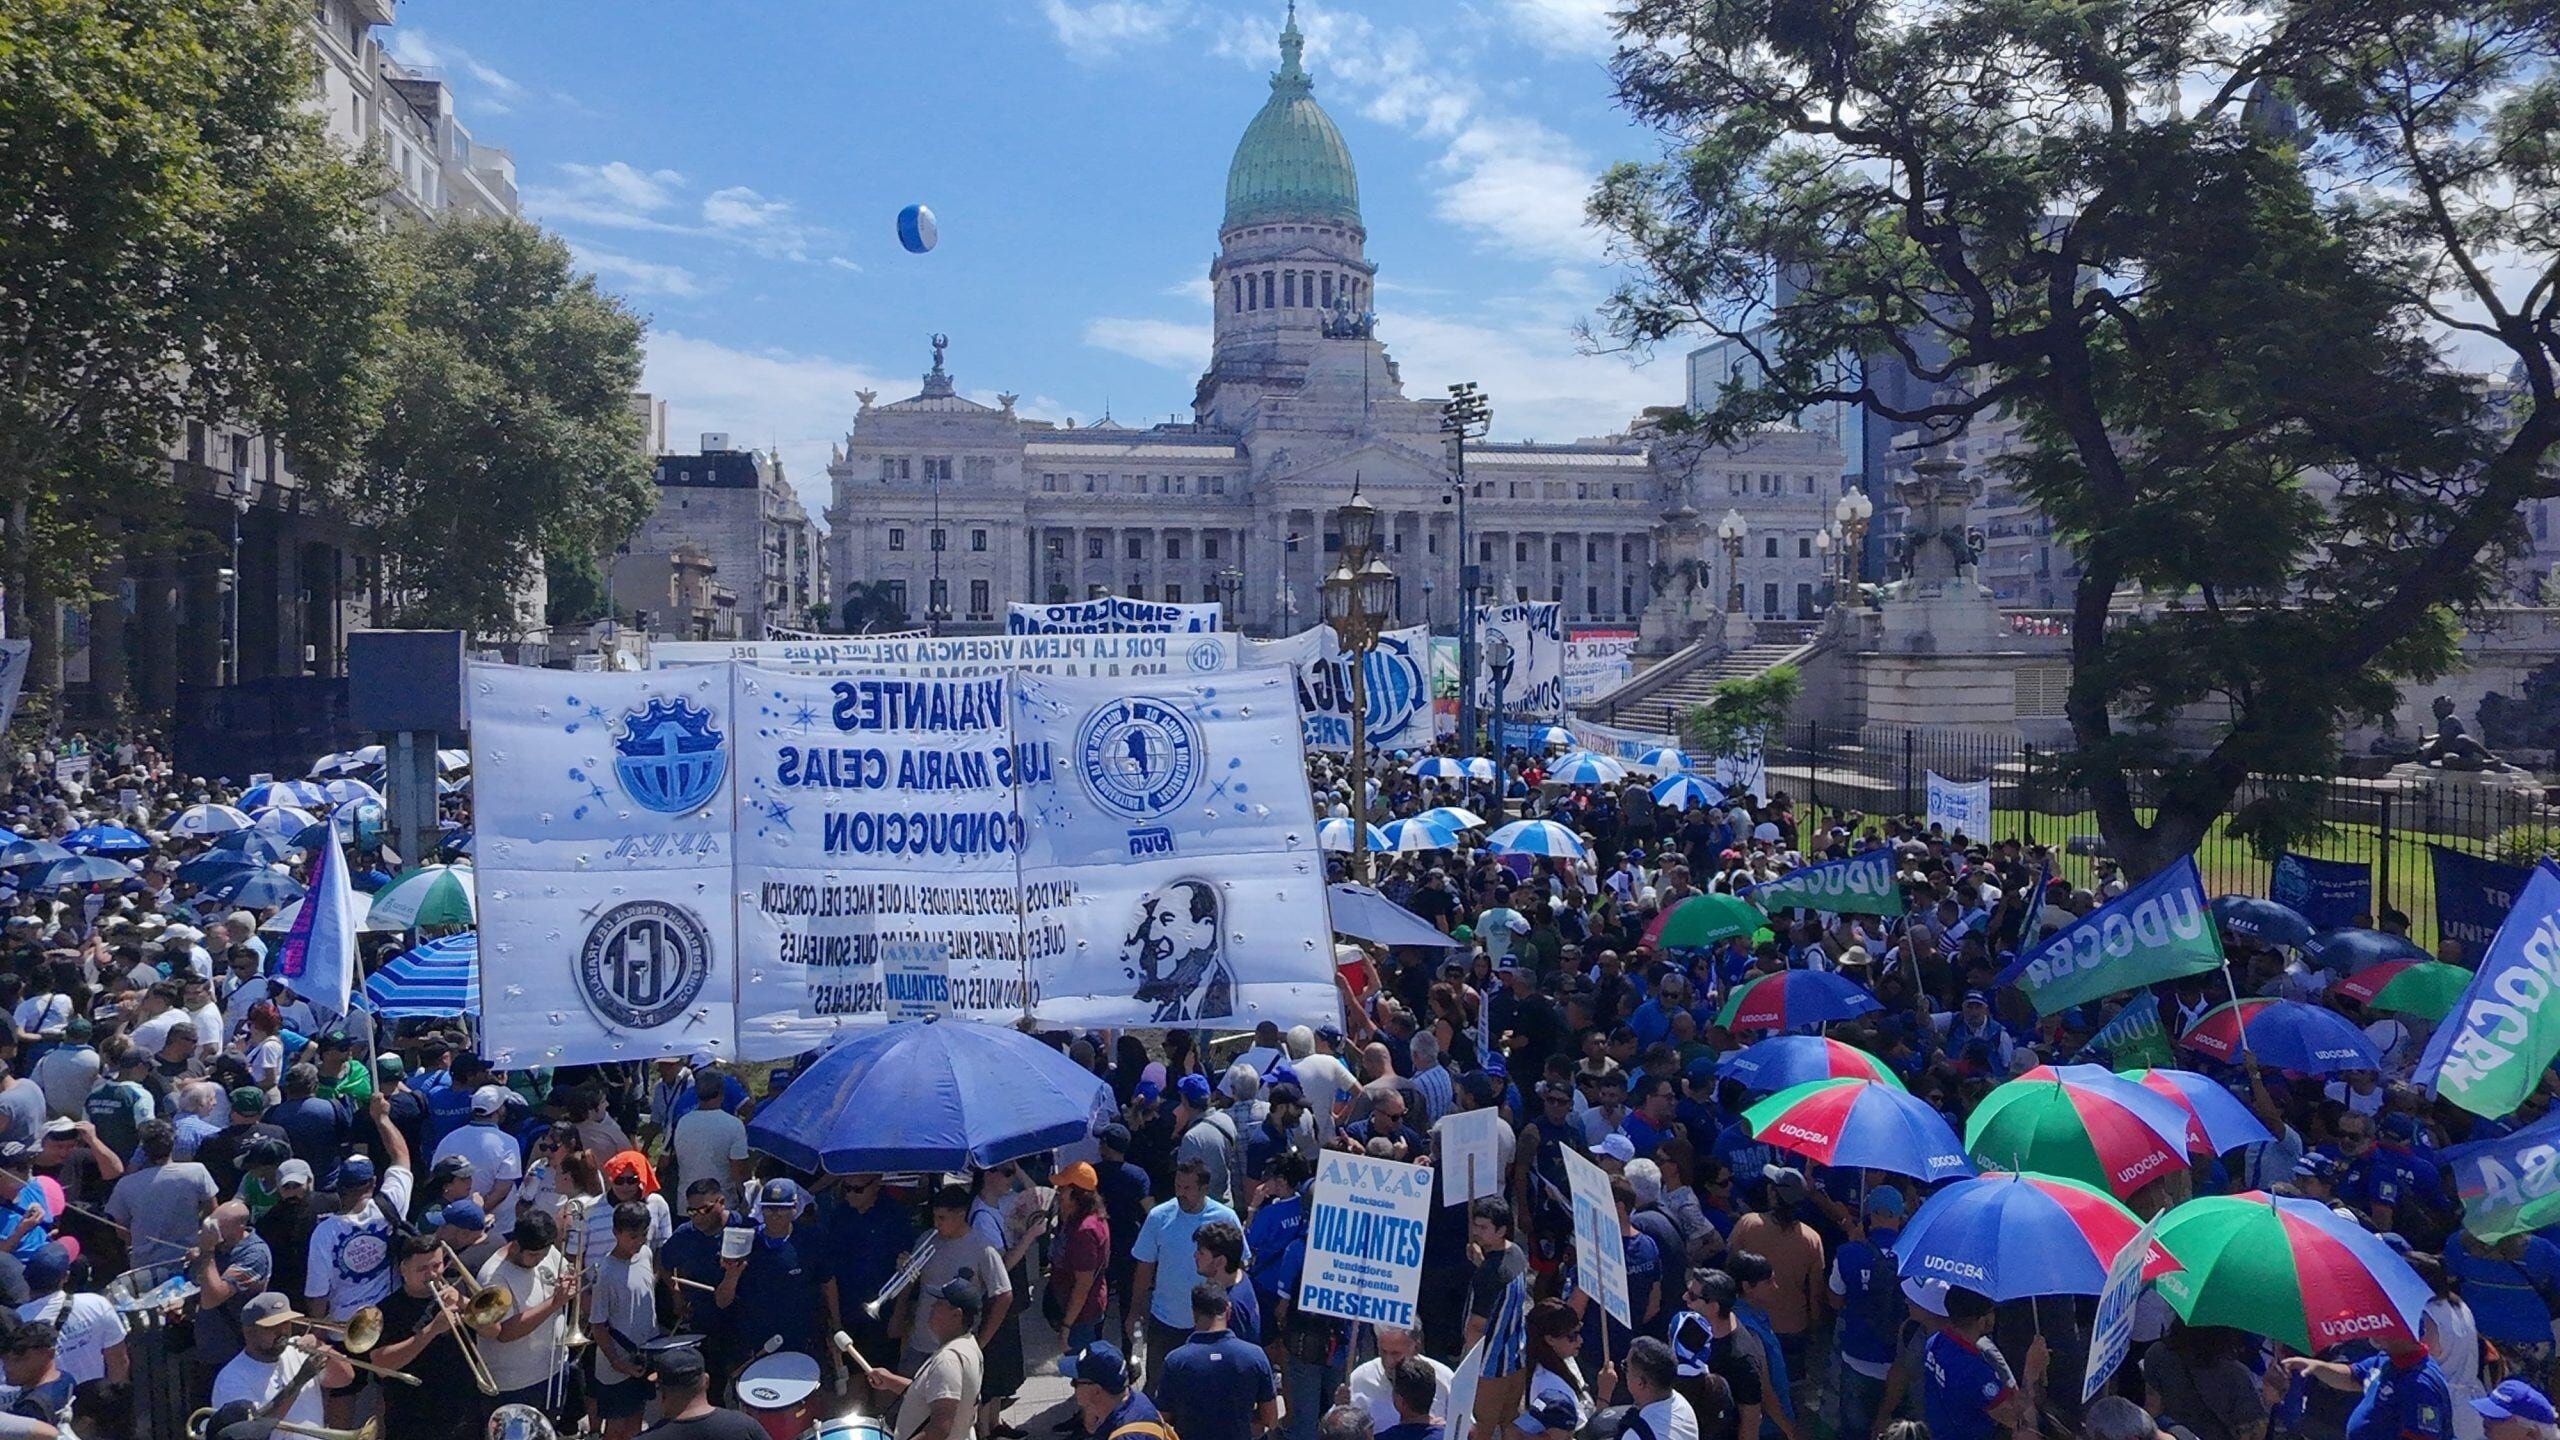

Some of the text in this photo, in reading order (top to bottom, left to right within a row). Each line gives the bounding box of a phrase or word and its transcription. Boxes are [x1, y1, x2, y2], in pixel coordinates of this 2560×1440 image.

[1707, 924, 1740, 938] UDOCBA
[885, 973, 949, 1002] VIAJANTES
[1741, 1013, 1779, 1022] UDOCBA
[2195, 1033, 2228, 1051] UDOCBA
[2315, 1049, 2359, 1060] UDOCBA
[1779, 1122, 1829, 1146] UDOCBA
[2117, 1150, 2169, 1184] UDOCBA
[1313, 1203, 1424, 1268] VIAJANTES
[1332, 1258, 1393, 1279] Vendedores
[1924, 1253, 1984, 1281] UDOCBA
[1322, 1271, 1400, 1294] de la Argentina
[1302, 1284, 1413, 1326] PRESENTE
[2320, 1313, 2395, 1337] UDOCBA
